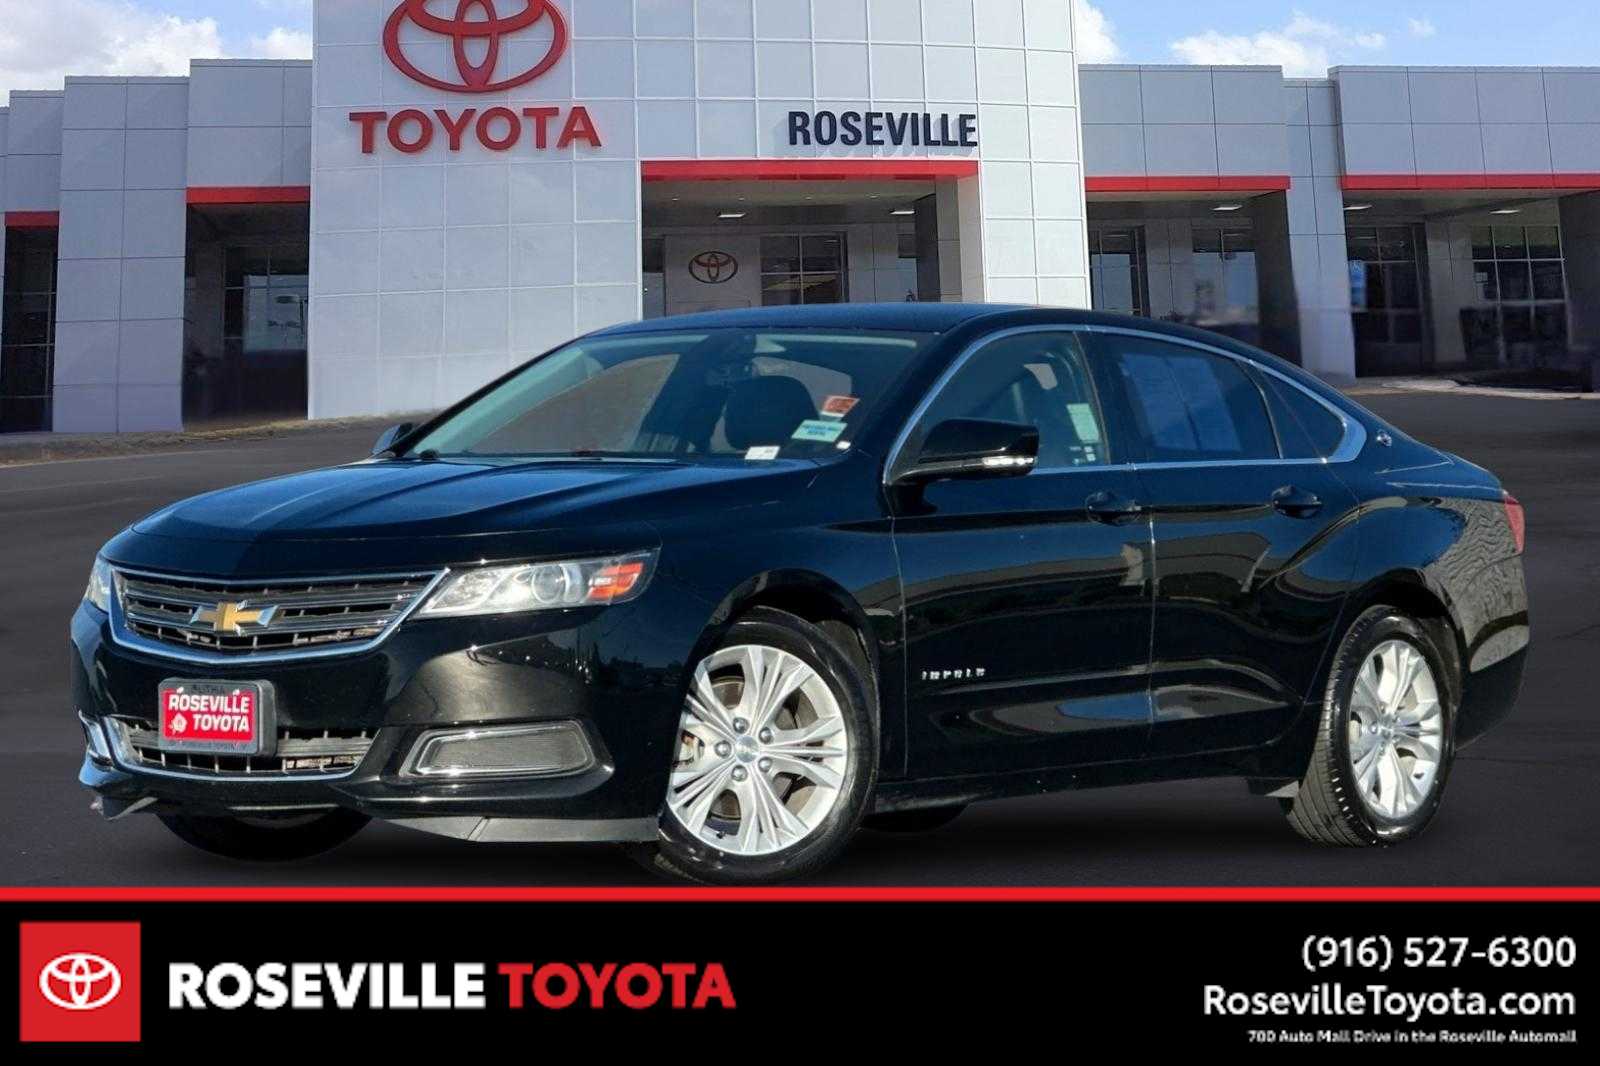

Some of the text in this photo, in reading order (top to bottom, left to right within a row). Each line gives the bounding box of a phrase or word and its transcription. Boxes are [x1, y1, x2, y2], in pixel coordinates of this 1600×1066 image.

[349, 106, 602, 154] TOYOTA
[788, 110, 978, 147] ROSEVILLE
[168, 694, 250, 713] ROSEVILLE
[192, 713, 250, 732] TOYOTA
